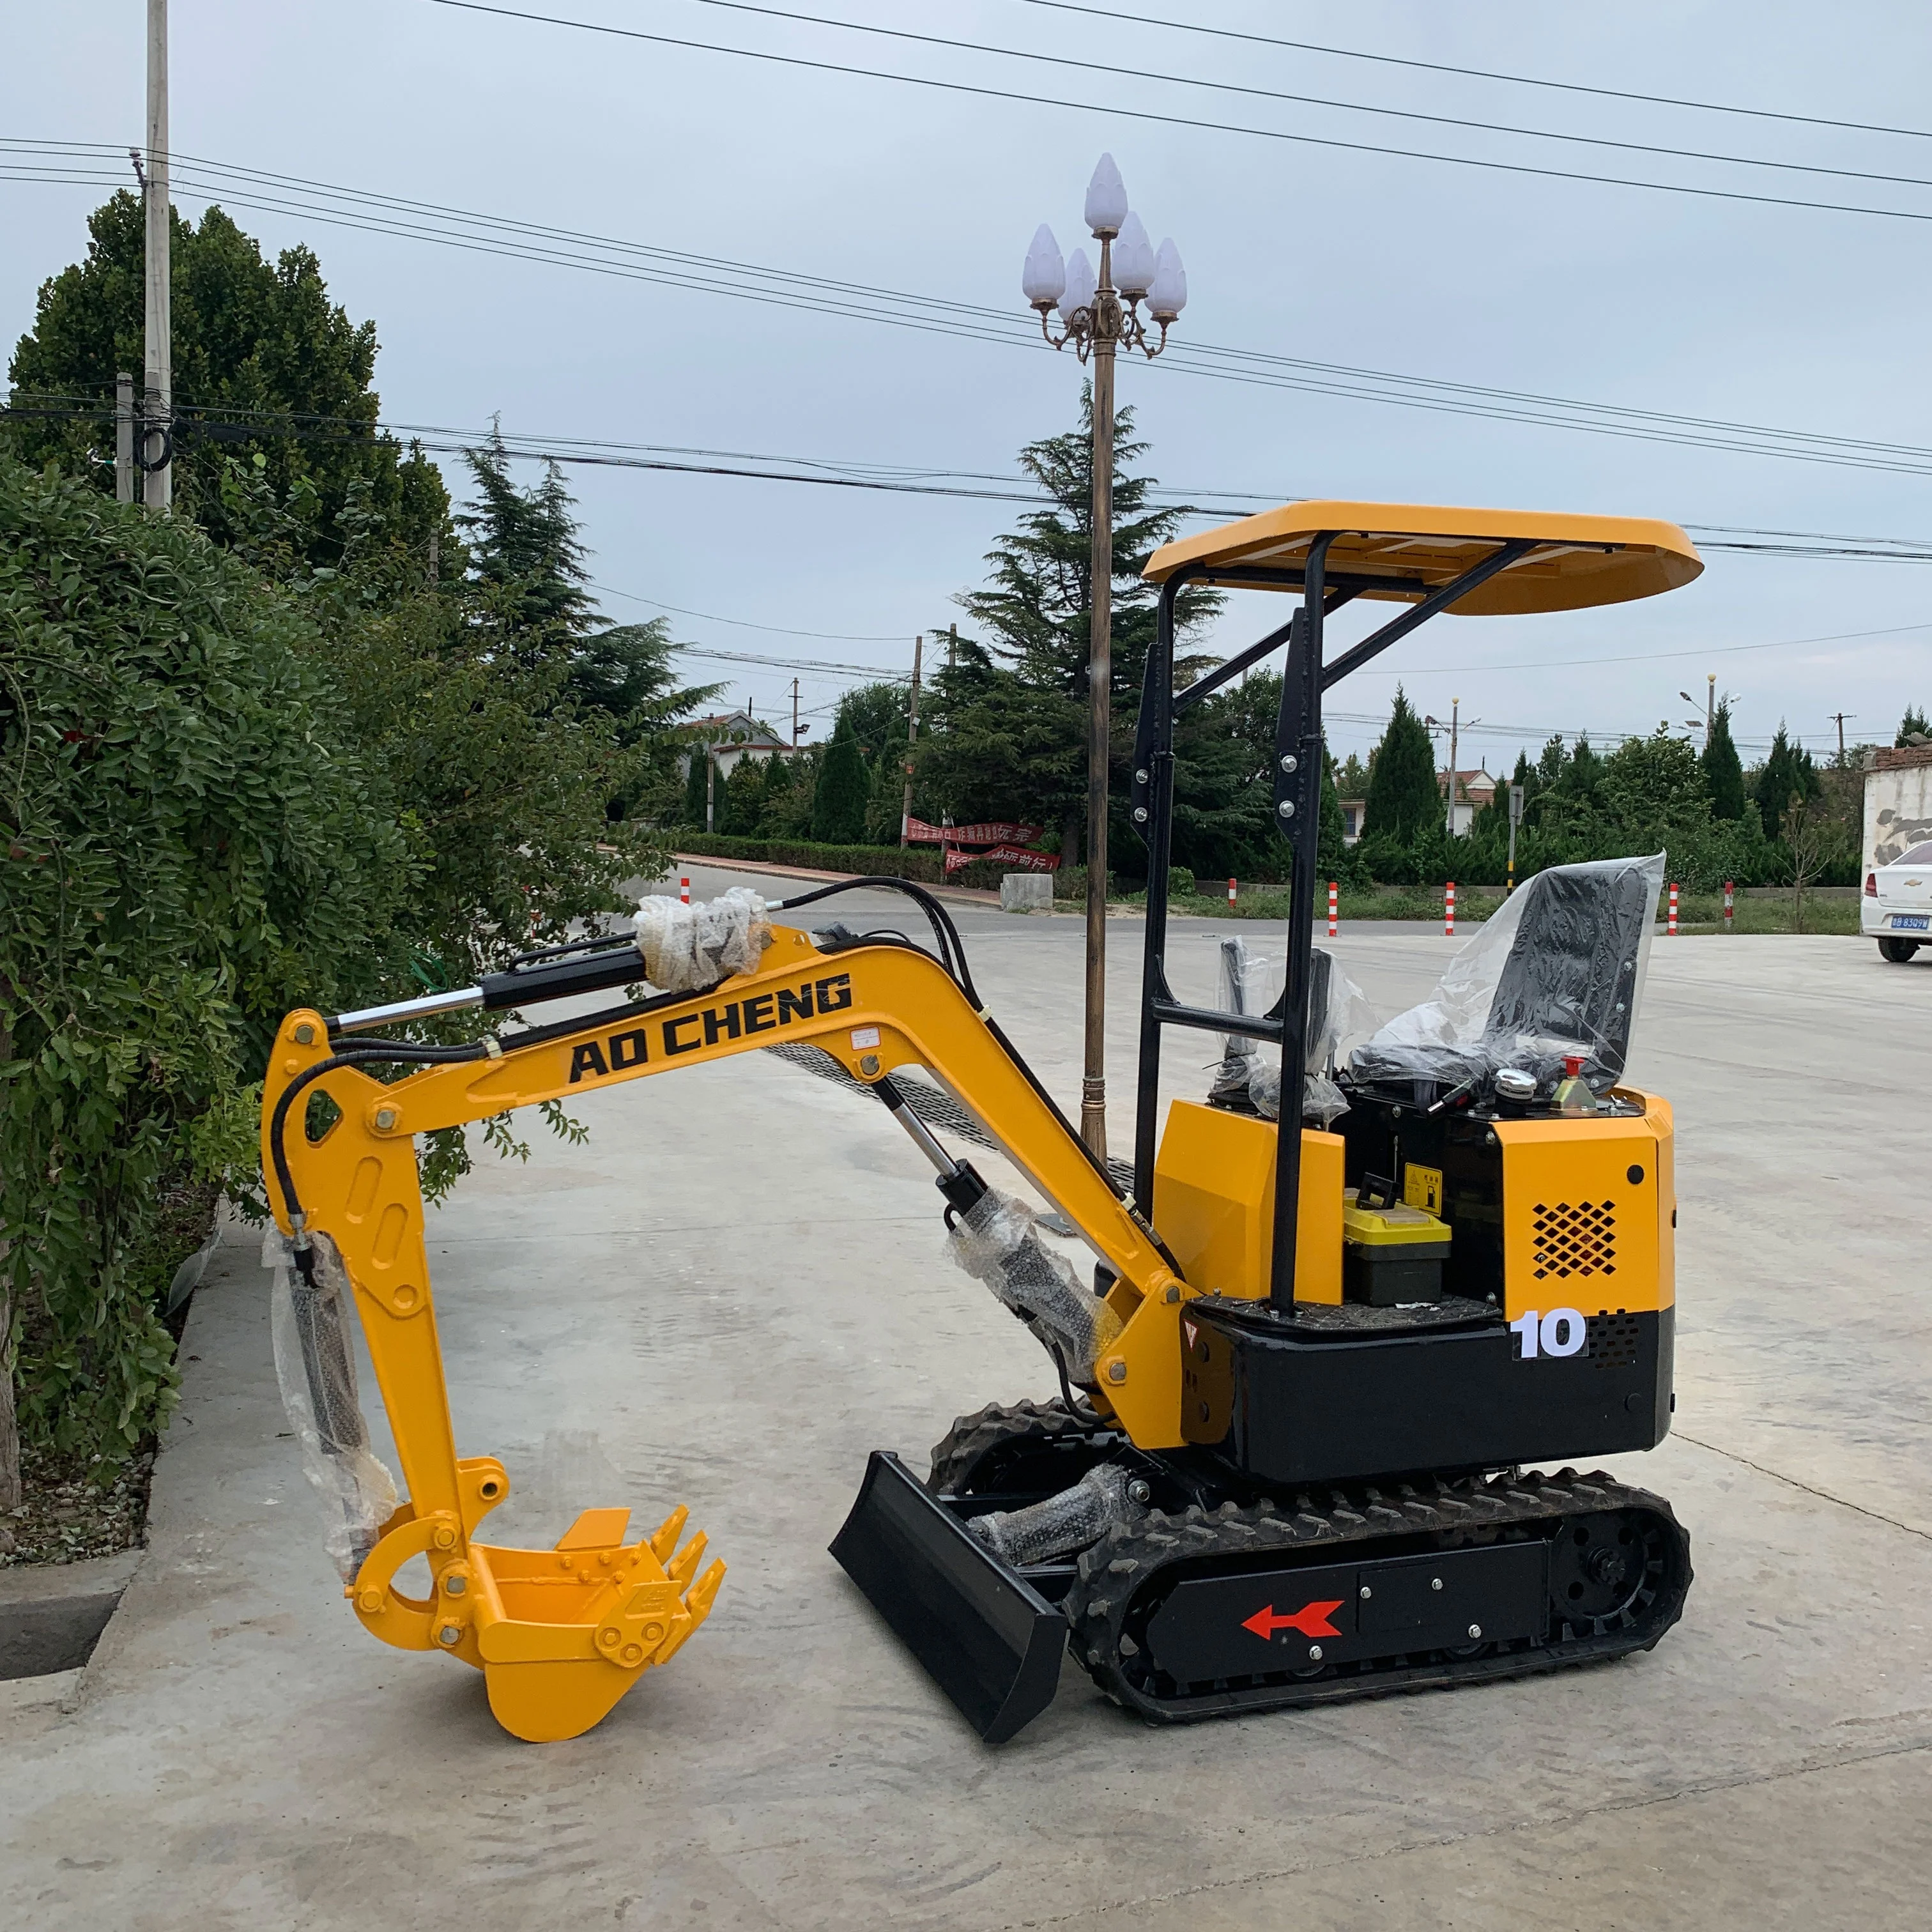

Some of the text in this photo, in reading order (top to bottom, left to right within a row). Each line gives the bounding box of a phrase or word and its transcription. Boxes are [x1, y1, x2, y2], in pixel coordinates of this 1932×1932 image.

[569, 973, 852, 1084] AO CHENG
[1510, 1307, 1586, 1358] 10
